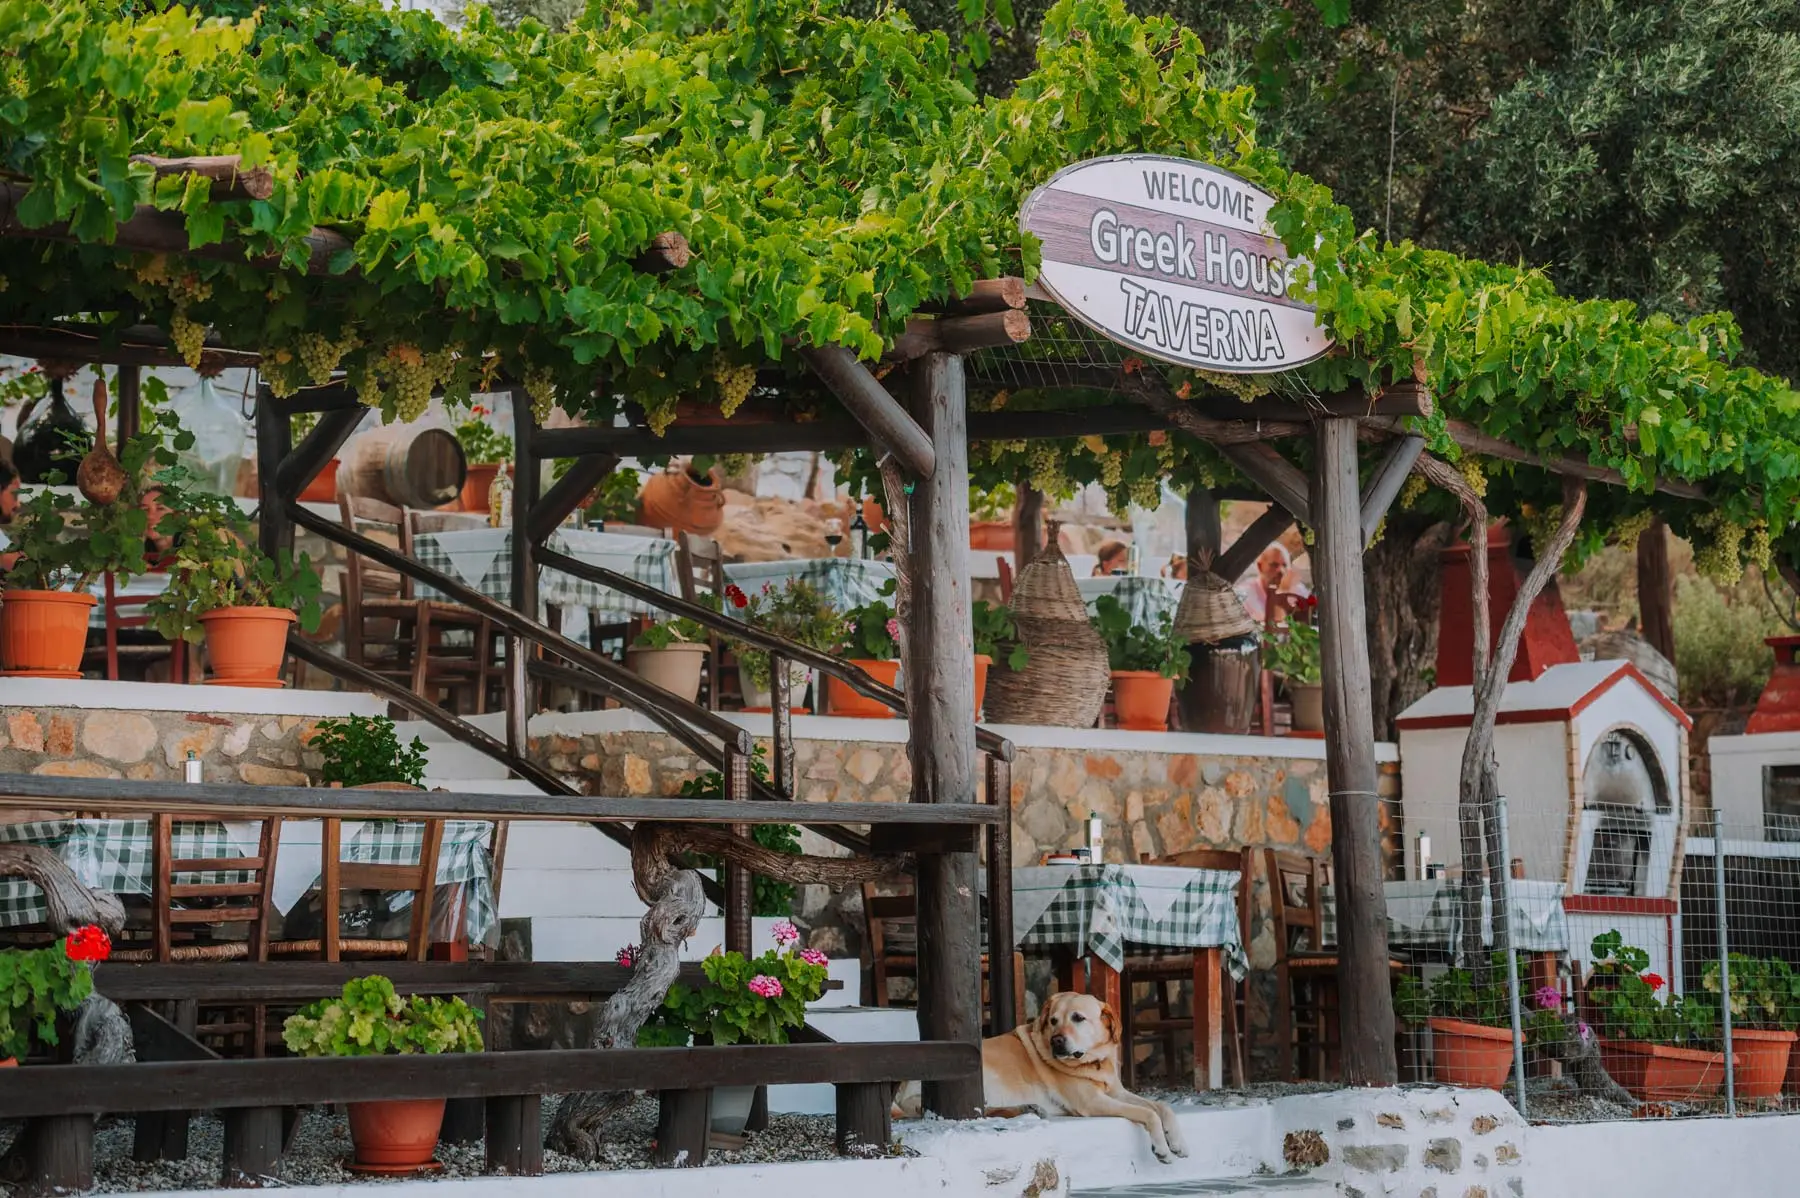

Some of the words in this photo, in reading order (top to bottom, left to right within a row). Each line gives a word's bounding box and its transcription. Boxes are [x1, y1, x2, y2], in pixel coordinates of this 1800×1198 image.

[1142, 170, 1255, 224] WELCOME
[1089, 207, 1197, 280] Greek
[1120, 277, 1285, 362] TAVERNA
